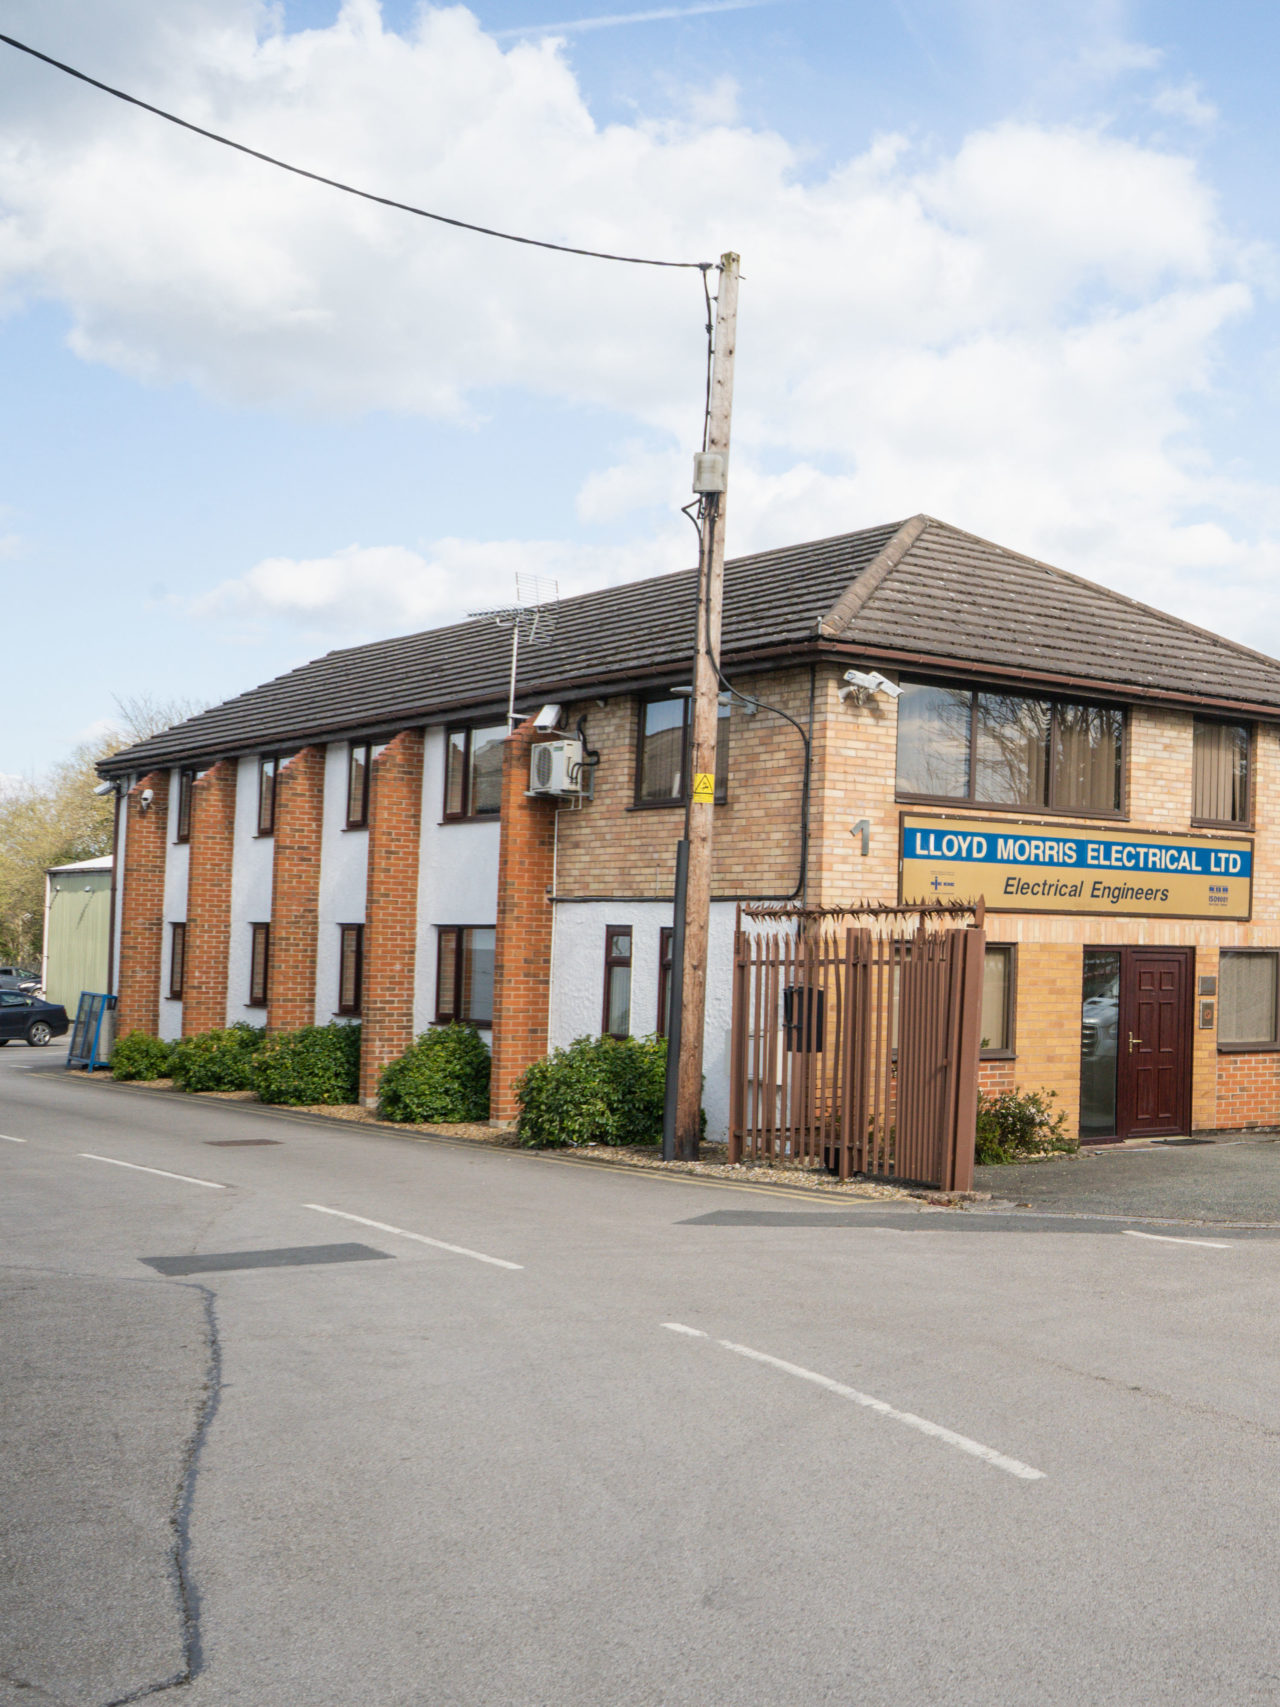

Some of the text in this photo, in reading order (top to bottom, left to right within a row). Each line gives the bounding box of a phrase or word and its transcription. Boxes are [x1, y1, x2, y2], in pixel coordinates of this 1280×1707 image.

[850, 819, 871, 856] 1
[915, 832, 1242, 873] LLOYD MORRIS ELECTRICAL LTD
[1003, 876, 1169, 904] Electrical Engineers
